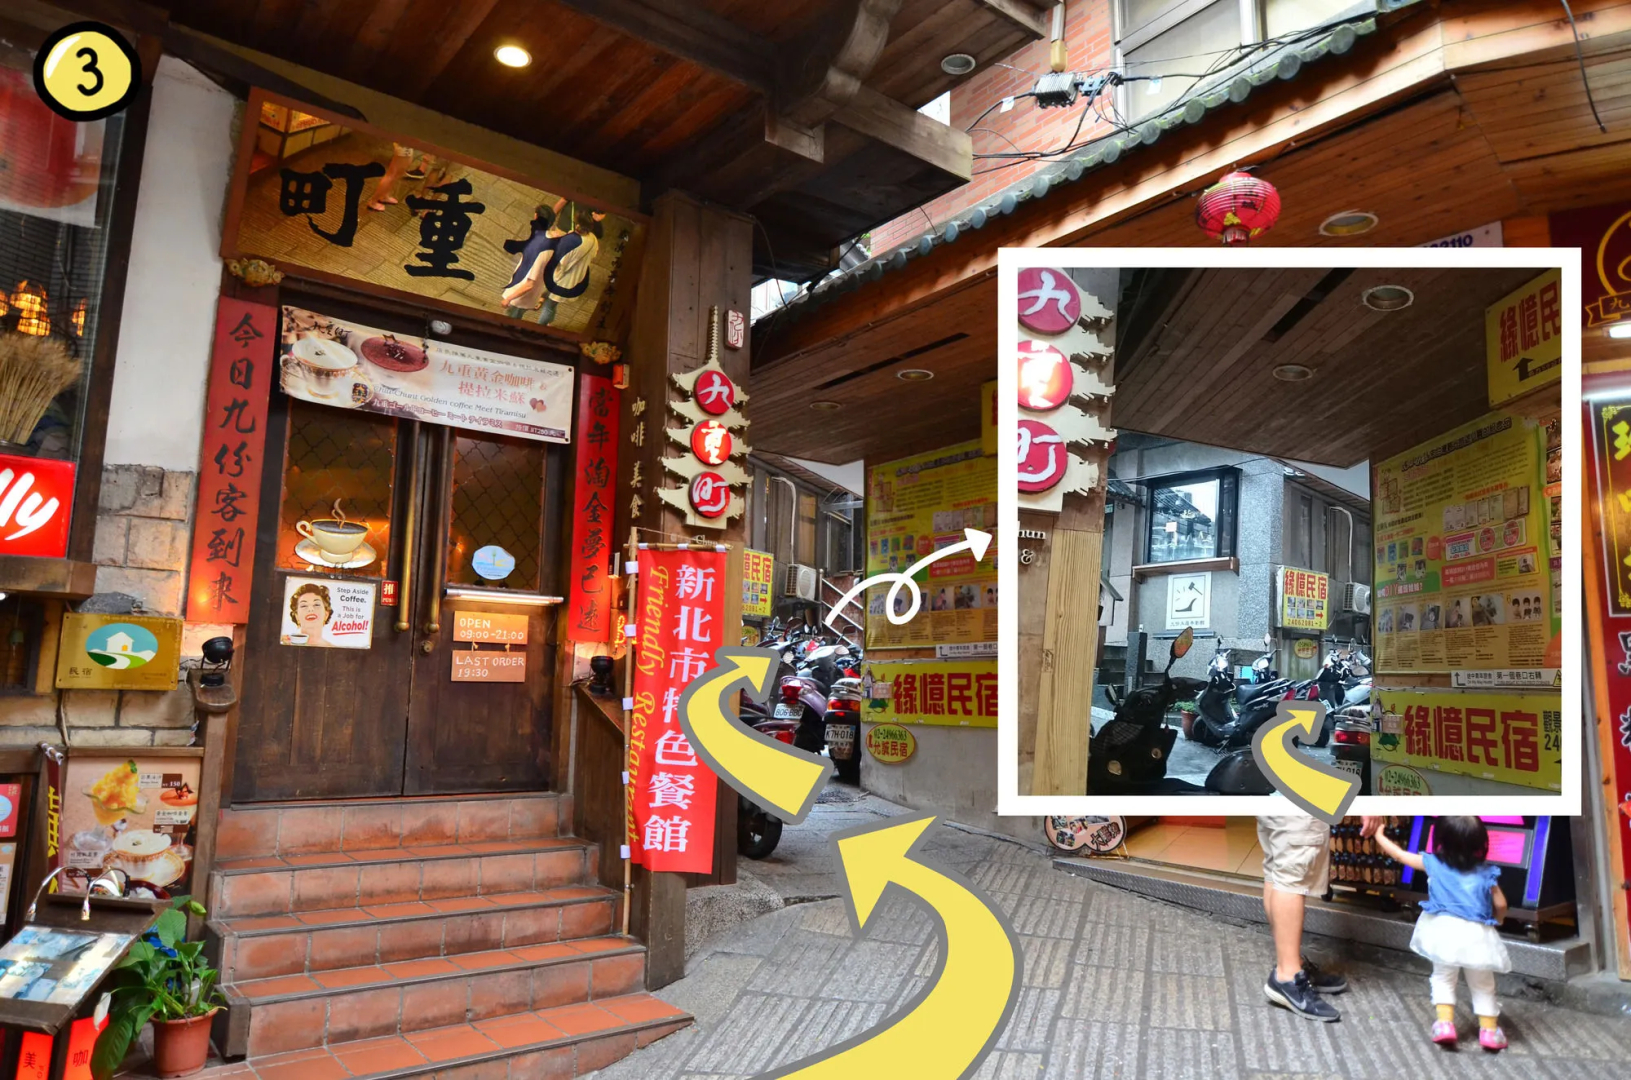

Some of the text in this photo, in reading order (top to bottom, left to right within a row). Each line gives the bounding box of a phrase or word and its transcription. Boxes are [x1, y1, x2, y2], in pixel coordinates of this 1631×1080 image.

[458, 380, 526, 404] 提拉米蘇
[420, 394, 448, 405] Golden
[450, 399, 474, 410] coffee
[475, 404, 493, 414] Meet
[495, 407, 527, 419] Tiramisu
[336, 587, 351, 596] Step
[339, 594, 367, 603] Coffee.
[331, 620, 369, 632] Alcohol!
[459, 617, 491, 629] OPEN
[635, 565, 669, 676] Friendly
[459, 629, 525, 640] 09:00-21:00
[455, 655, 525, 667] LAST ORDER
[69, 667, 92, 676] 民宿
[457, 668, 489, 678] 19:30
